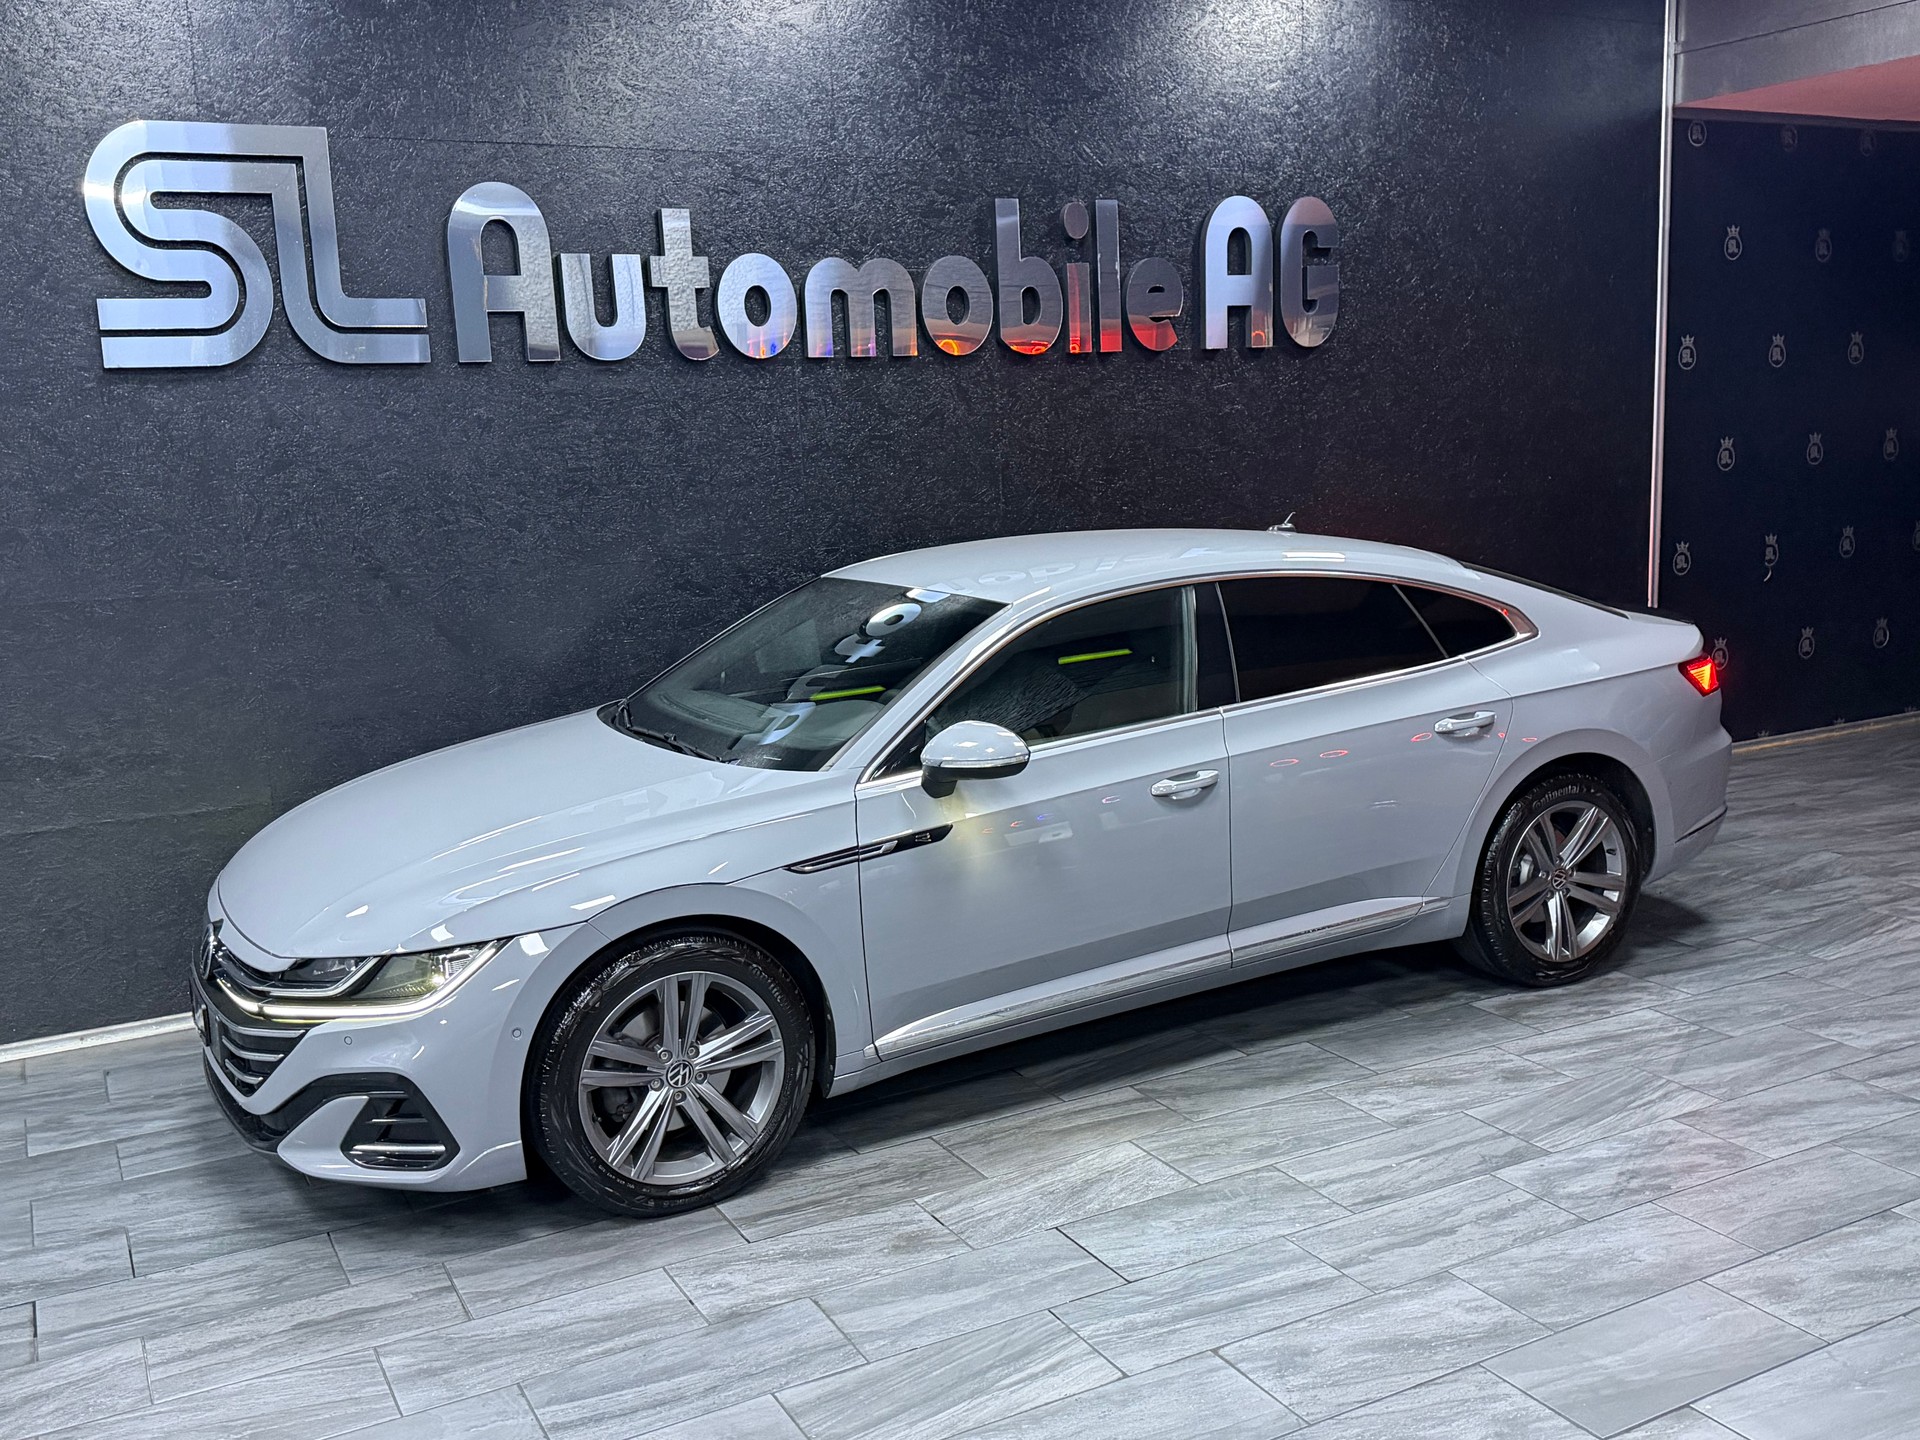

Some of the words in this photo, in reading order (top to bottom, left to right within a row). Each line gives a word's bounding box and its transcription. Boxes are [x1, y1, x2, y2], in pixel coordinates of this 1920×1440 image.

[84, 120, 431, 369] SL
[447, 181, 1185, 364] Automobile
[1203, 195, 1340, 350] AG
